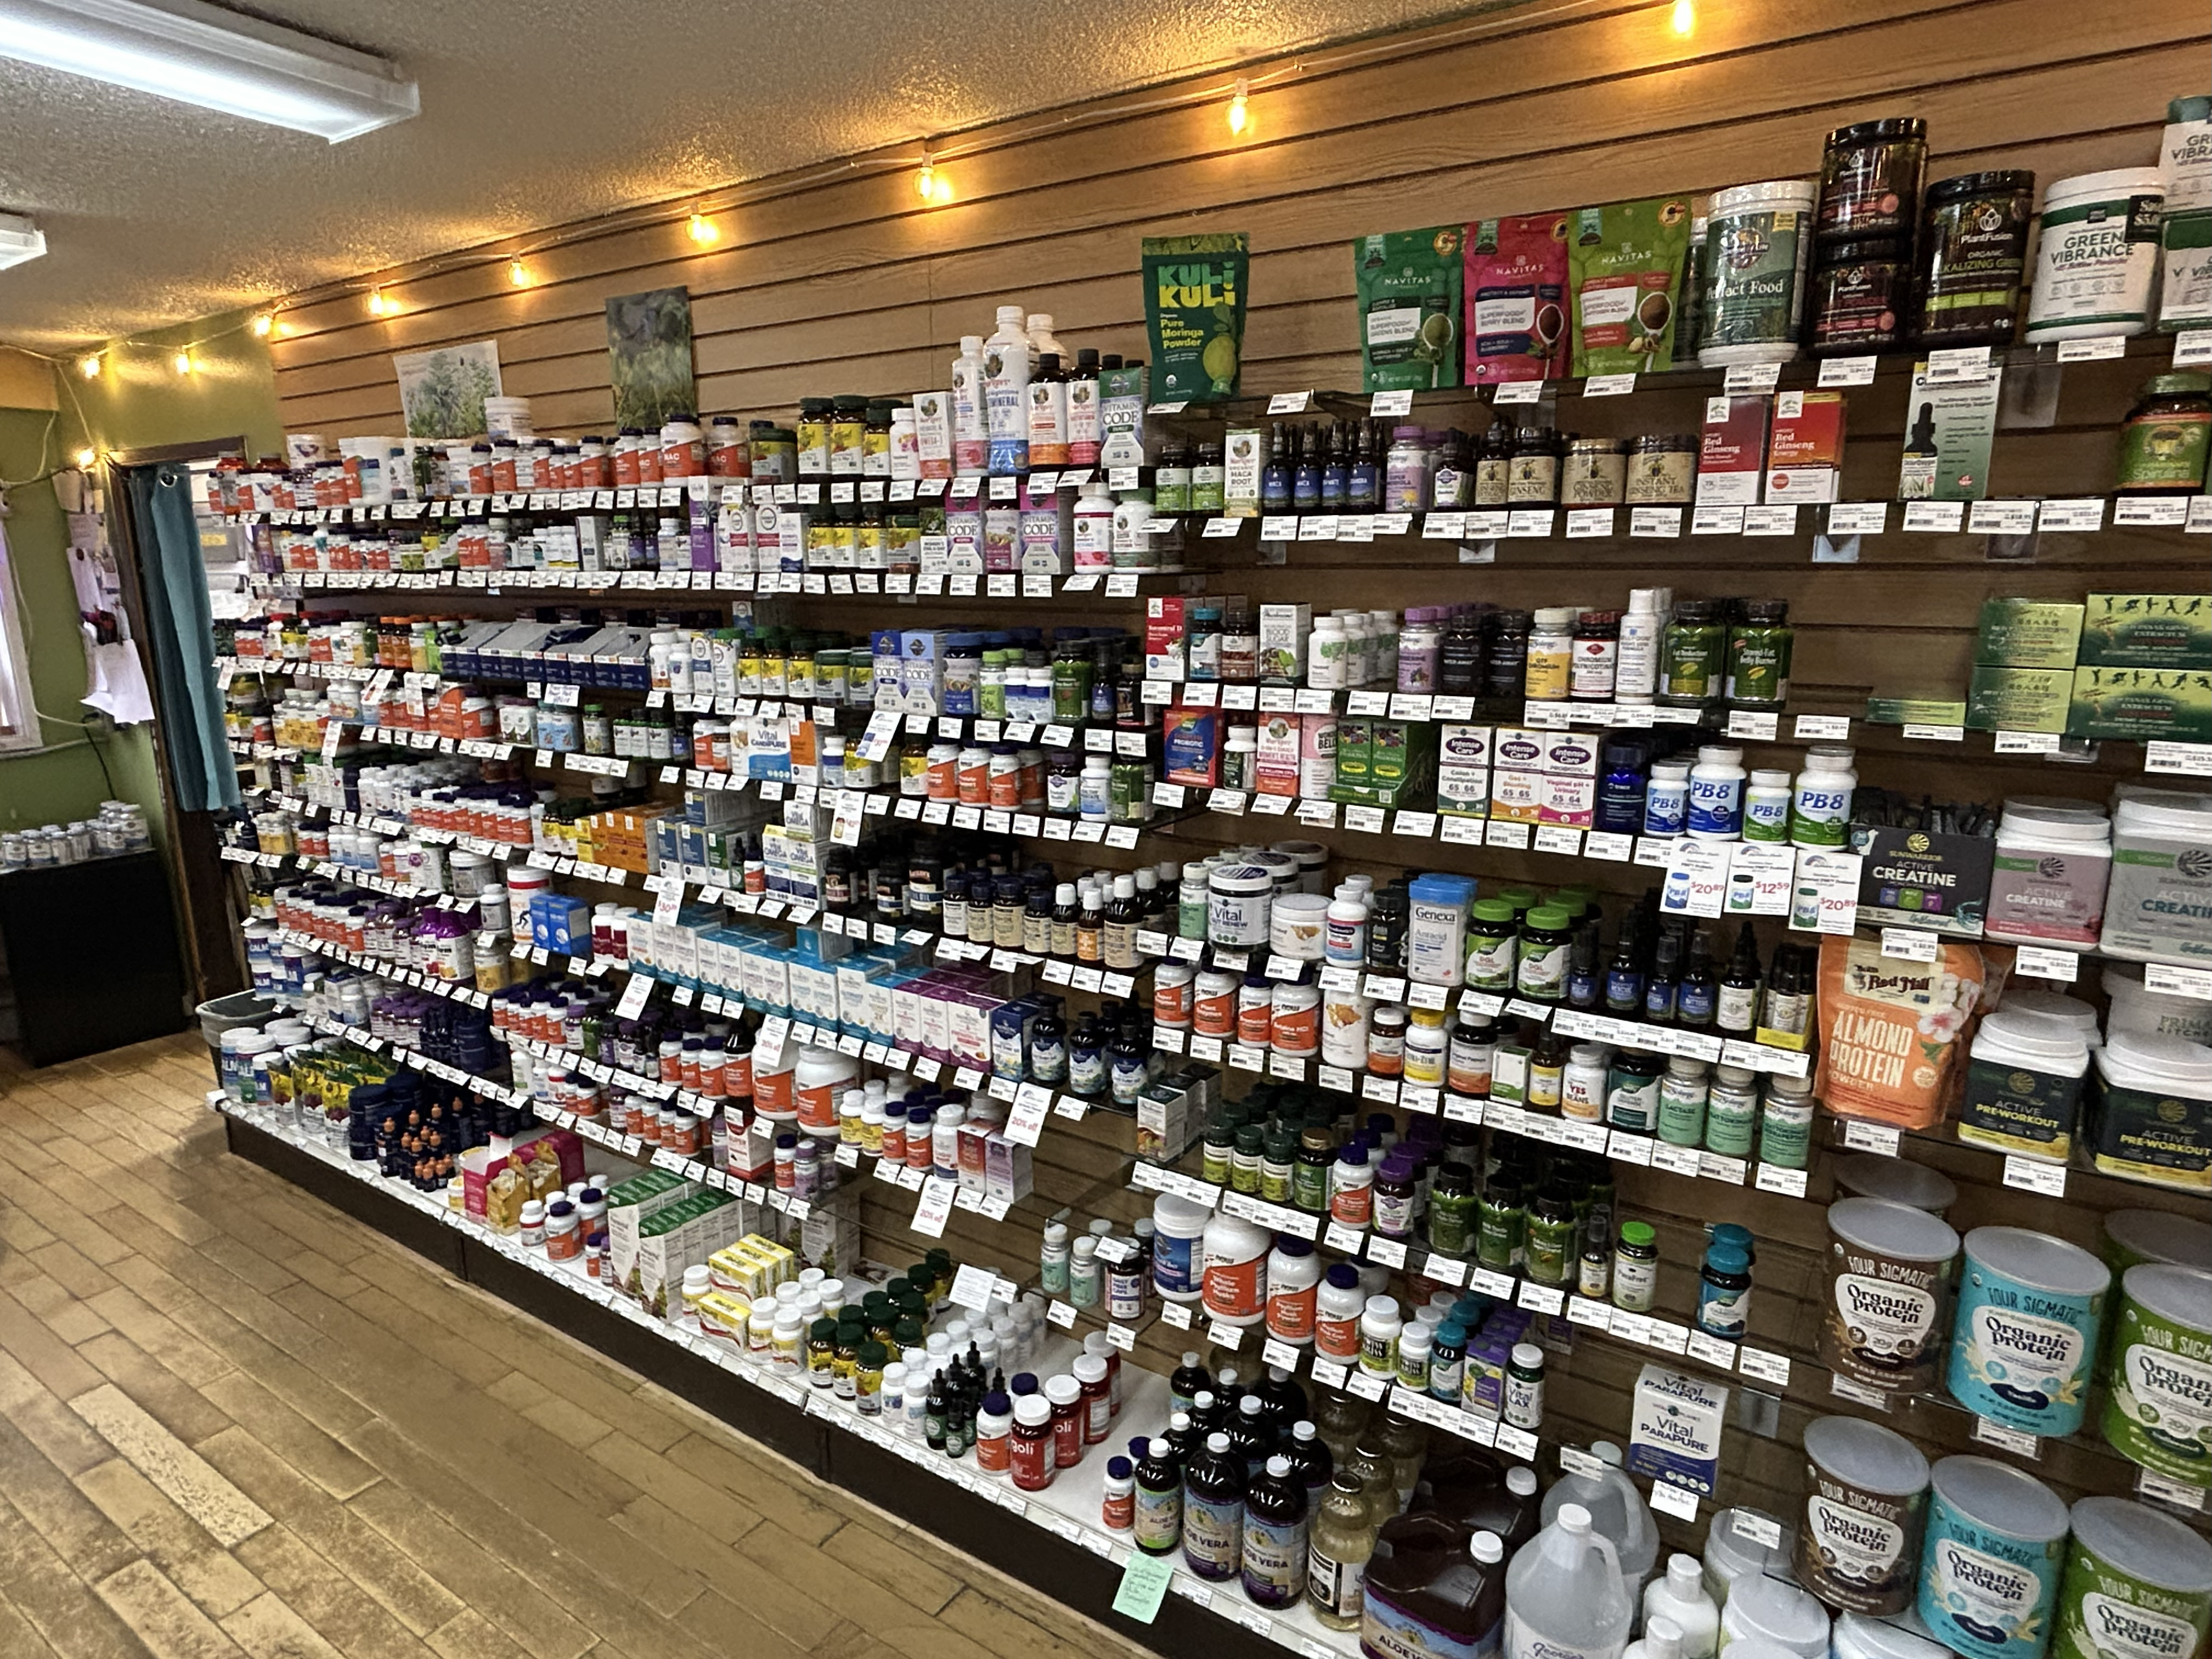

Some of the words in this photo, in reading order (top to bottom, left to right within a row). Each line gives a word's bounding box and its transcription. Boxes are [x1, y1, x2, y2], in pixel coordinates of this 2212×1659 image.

[2186, 133, 2212, 146] GRE
[2170, 147, 2212, 160] VIBRA
[1961, 233, 2013, 244] PlantFusion
[2064, 232, 2123, 249] GREEN
[1601, 251, 1652, 265] NAVITAS
[2051, 244, 2135, 264] VIBRANCE
[1496, 264, 1543, 275] NAVITAS
[1943, 260, 1994, 273] KALIZING
[1996, 258, 2023, 269] GREE
[1385, 277, 1431, 285] NAVITAS
[1750, 279, 1783, 294] Food
[1160, 319, 1184, 328] Pure
[1162, 329, 1204, 338] Moringa
[1163, 338, 1201, 349] Powder
[1102, 410, 1139, 425] CODE
[1705, 437, 1722, 445] Red
[1775, 433, 1795, 442] Red
[1703, 444, 1740, 455] Ginseng
[1774, 441, 1815, 450] Ginseng
[949, 524, 978, 536] CODE
[1023, 523, 1056, 535] CODE
[1452, 740, 1480, 748] Intense
[1505, 744, 1535, 753] Intense
[1555, 749, 1587, 758] Intense
[1692, 781, 1730, 799] PB8
[1651, 797, 1680, 809] PB8
[1800, 791, 1844, 809] PB8
[1753, 804, 1784, 817] PB8
[1897, 861, 1934, 871] ACTIVE
[1872, 867, 1956, 887] CREATINE
[2006, 894, 2066, 909] CREATINE
[2024, 888, 2072, 900] ACTIVE
[1214, 907, 1243, 922] Vital
[1415, 906, 1456, 923] Genexa
[1867, 975, 1898, 991] Red
[2160, 1015, 2212, 1031] PRIM
[1832, 1010, 1914, 1057] ALMOND
[1829, 1040, 1906, 1088] PROTEIN
[1570, 1085, 1587, 1095] YES
[1995, 1099, 2042, 1116] ACTIVE
[1976, 1103, 2059, 1128] PRE-WORKOUT
[2141, 1130, 2194, 1144] ACTIVE
[2119, 1135, 2212, 1156] PRE-WORKOUT
[1847, 1284, 1923, 1313] Organic
[1852, 1297, 1920, 1324] protein
[1985, 1317, 2072, 1350] Organic
[1991, 1330, 2066, 1363] protein
[2179, 1335, 2212, 1363] SIGM
[1664, 1376, 1703, 1395] Vital
[1644, 1380, 1718, 1409] PARAPURE
[1656, 1415, 1694, 1438] Vital
[1640, 1423, 1709, 1453] PARAPURE
[1818, 1505, 1891, 1544] Organic
[1200, 1538, 1230, 1549] VERA
[1822, 1519, 1888, 1553] protein
[1260, 1556, 1289, 1570] VERA
[1946, 1549, 2028, 1593] Organic
[1953, 1566, 2023, 1602] protein
[2096, 1603, 2186, 1645] Organic
[1379, 1634, 1410, 1656] ALOE
[2104, 1622, 2181, 1655] protein
